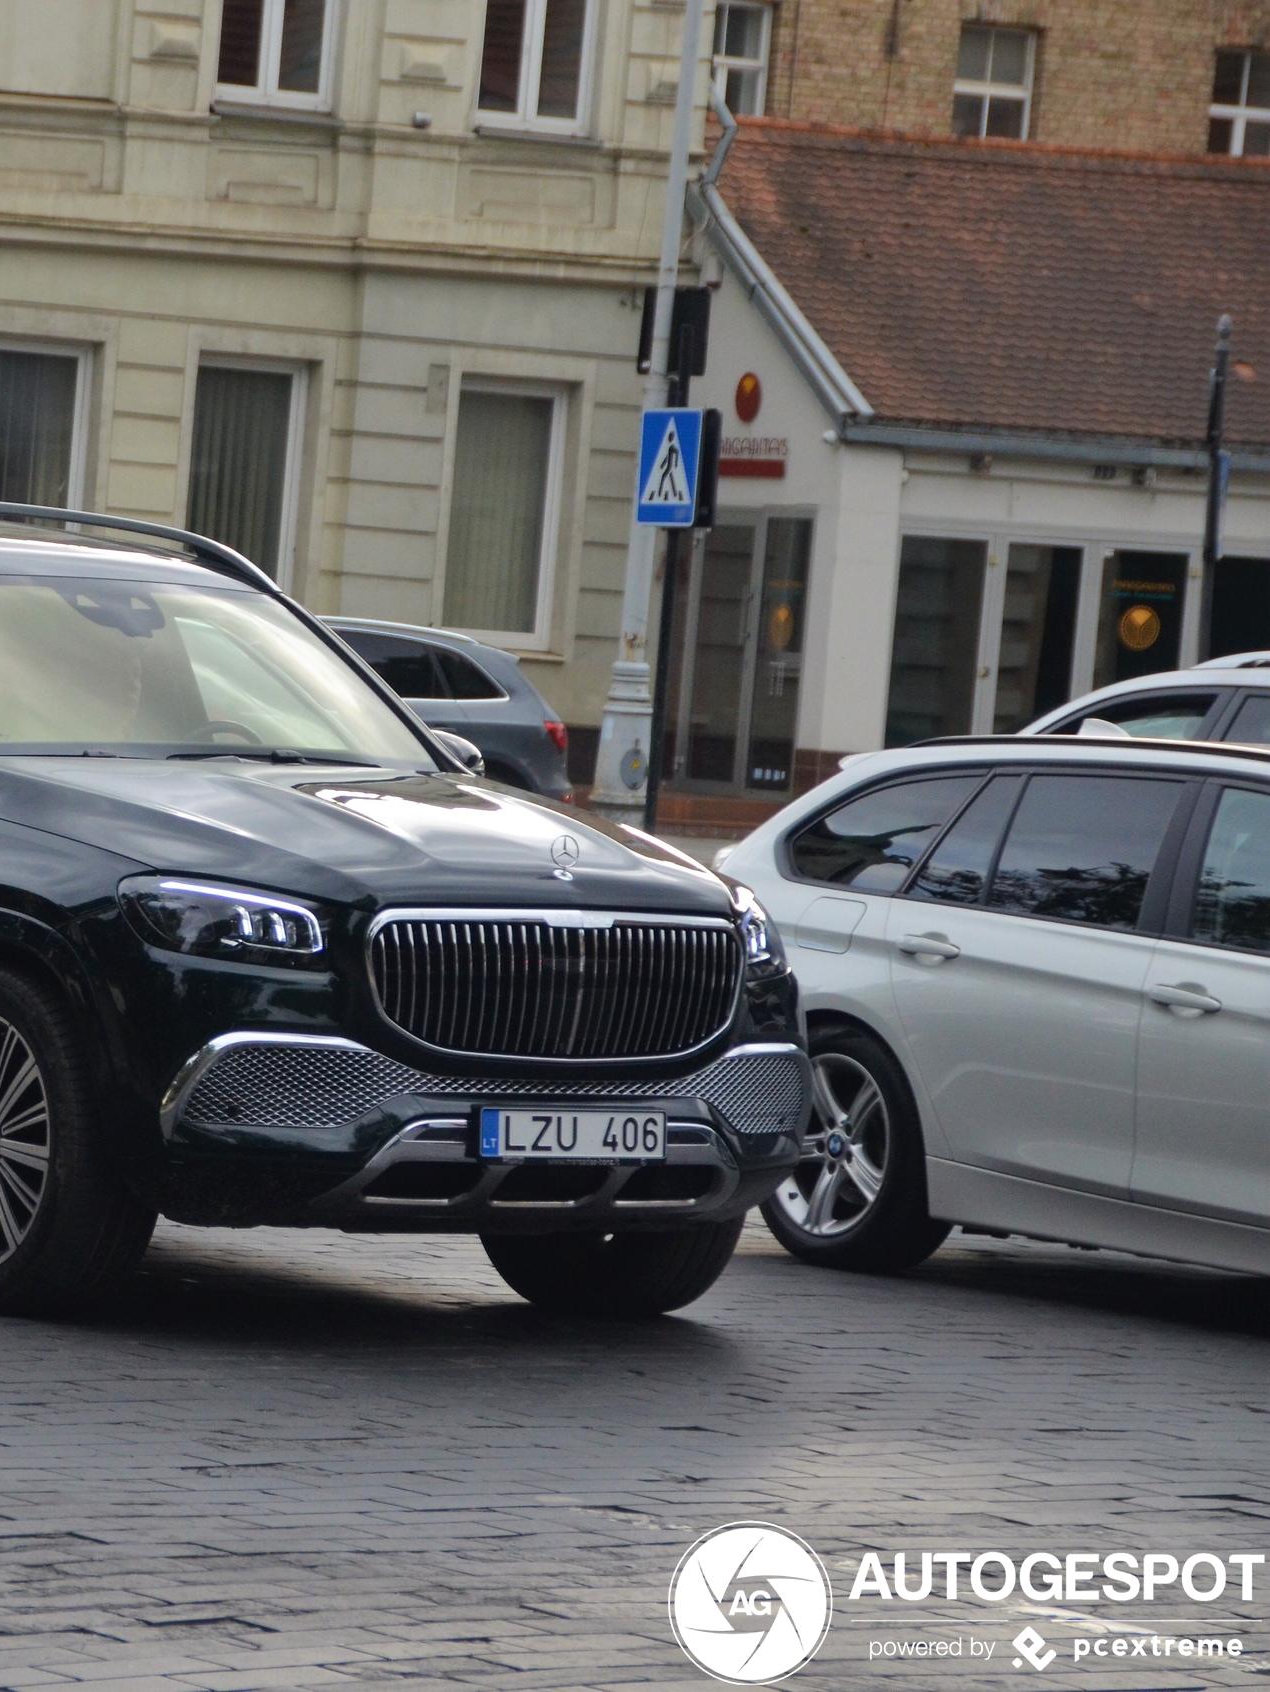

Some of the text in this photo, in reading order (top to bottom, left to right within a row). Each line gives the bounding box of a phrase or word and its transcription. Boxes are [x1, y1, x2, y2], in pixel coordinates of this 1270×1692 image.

[483, 1138, 497, 1148] LT
[505, 1115, 658, 1152] LZU 406
